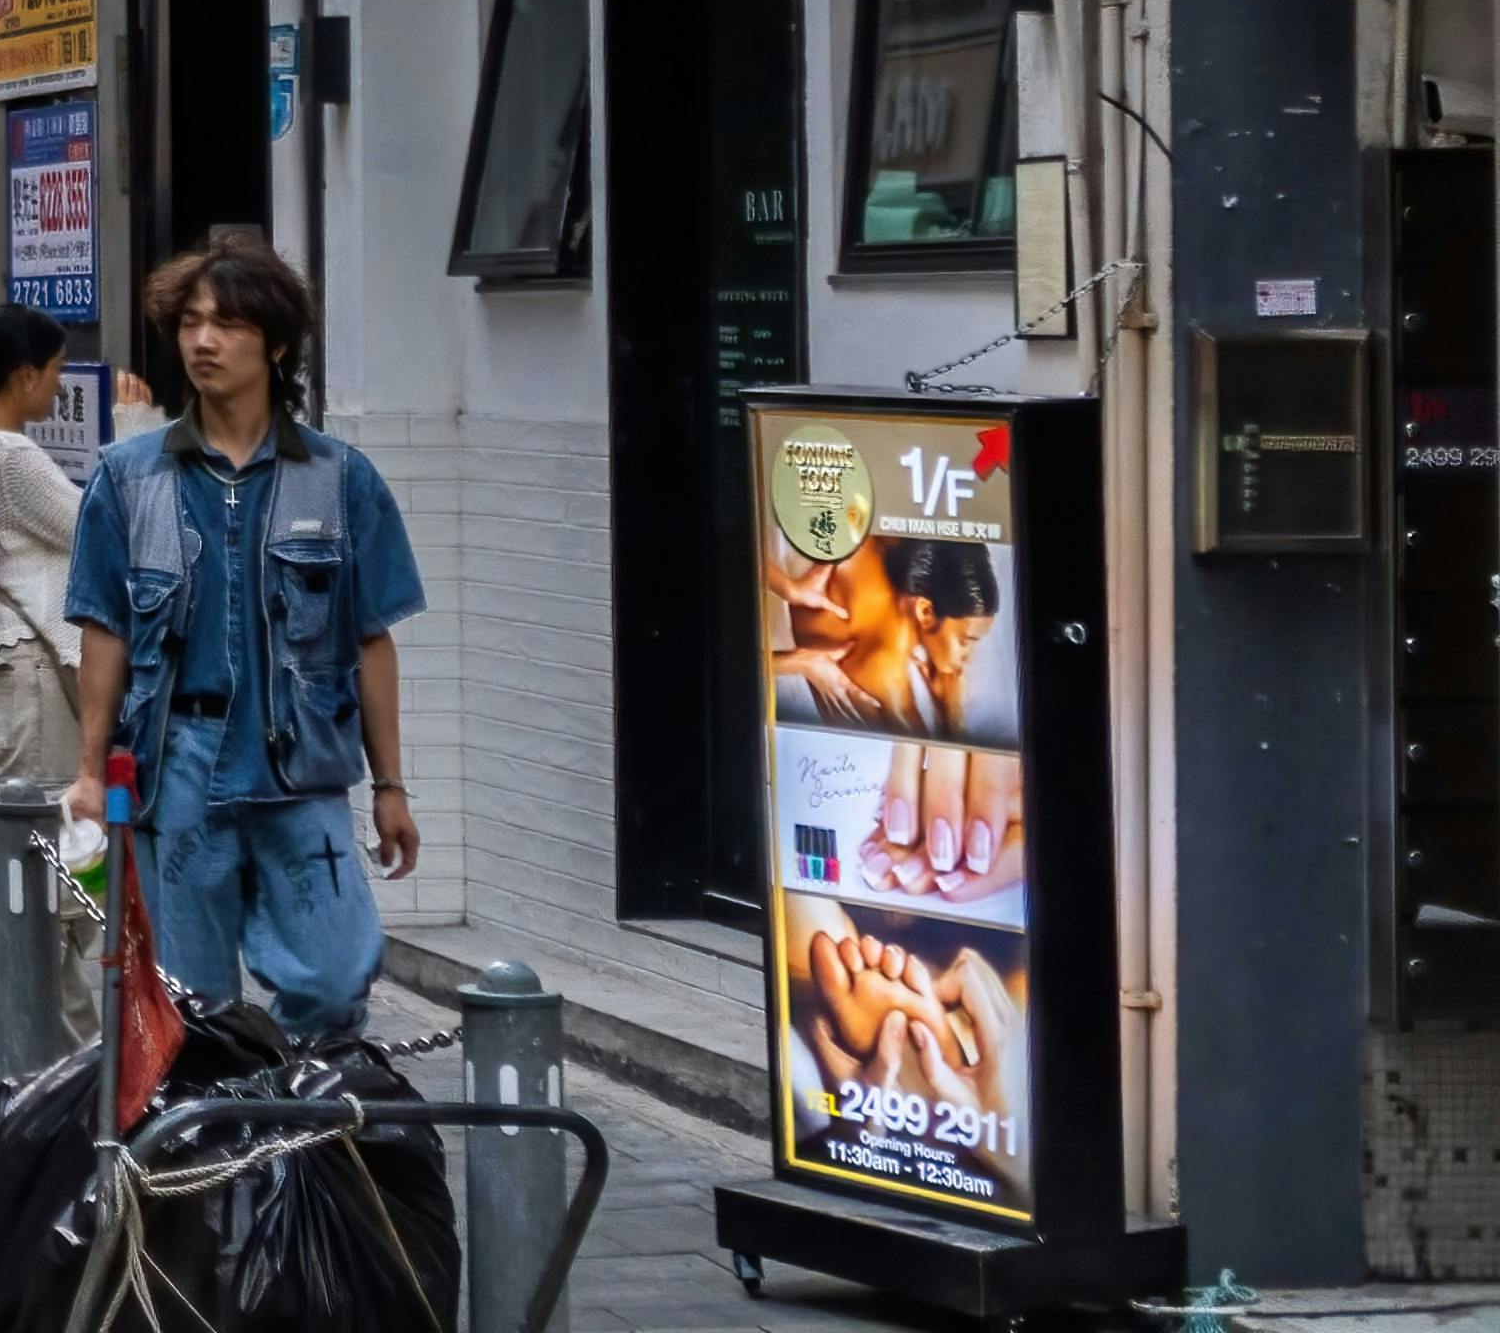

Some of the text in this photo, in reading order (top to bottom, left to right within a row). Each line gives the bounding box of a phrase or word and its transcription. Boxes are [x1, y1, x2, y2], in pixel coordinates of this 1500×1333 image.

[746, 190, 784, 222] BAR
[13, 279, 93, 307] 2721 6833
[1405, 447, 1463, 468] 2499
[798, 466, 845, 493] FOOT
[899, 446, 977, 518] 1/F
[805, 1080, 1017, 1157] TEL 2499 2911
[858, 1130, 957, 1165] Opening Hours:
[826, 1139, 901, 1176] 11:30am
[916, 1161, 994, 1198] 12:30am
